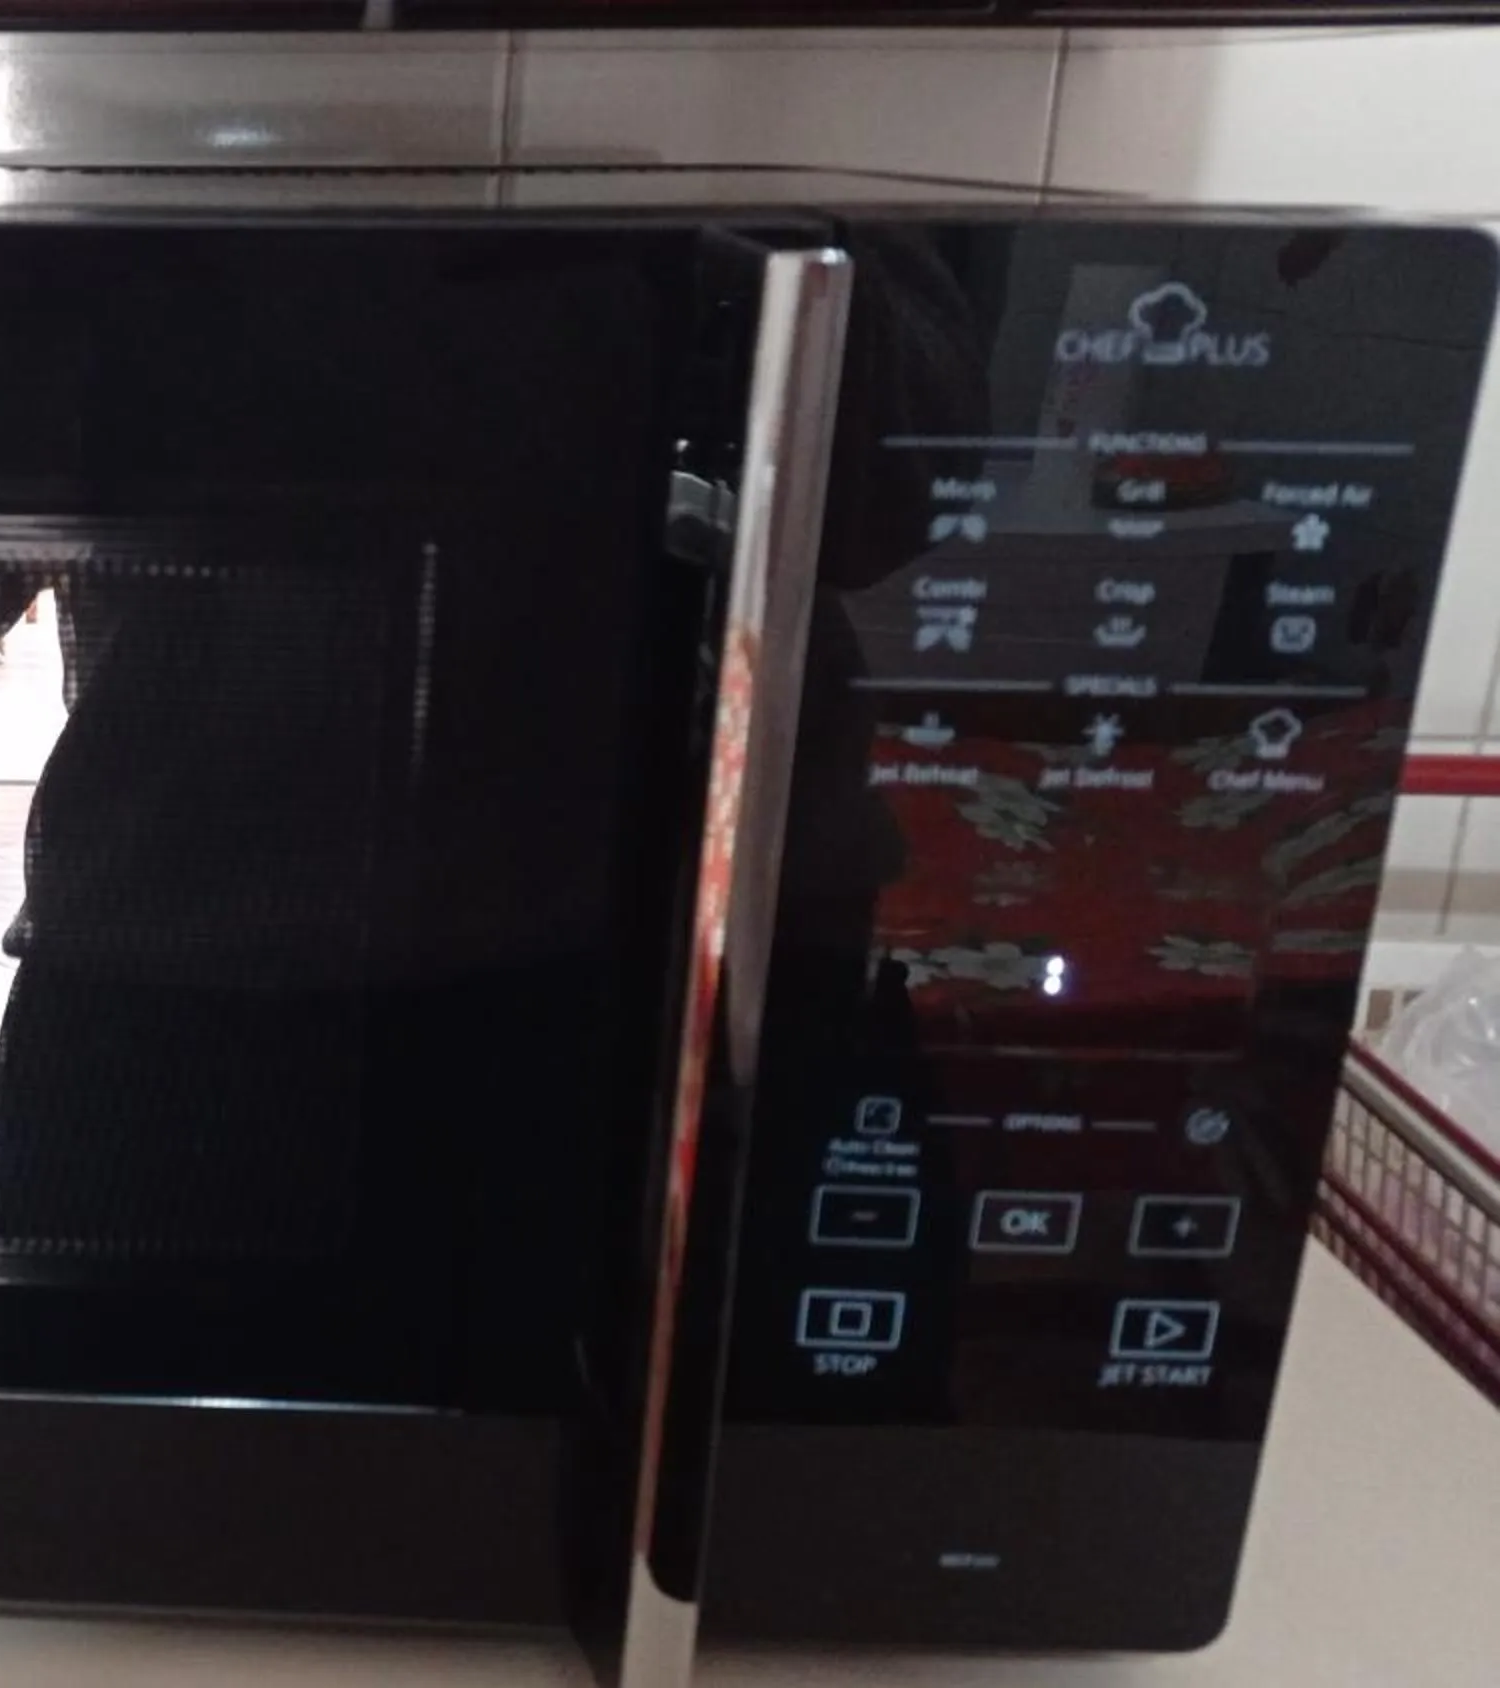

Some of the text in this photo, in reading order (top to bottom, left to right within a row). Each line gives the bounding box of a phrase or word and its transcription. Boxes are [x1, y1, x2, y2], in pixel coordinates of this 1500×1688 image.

[1055, 330, 1271, 365] CHEF PLUS
[1089, 433, 1206, 452] FUNCTIONS
[1116, 479, 1166, 504] Grill
[1261, 481, 1373, 508] Forced Air
[914, 577, 987, 602] Combi
[1098, 579, 1155, 605] Crisp
[1267, 582, 1334, 606] Steam
[1062, 675, 1156, 696] SPECIALS
[1208, 770, 1324, 792] Chef Menu
[1000, 1208, 1050, 1236] OK
[814, 1353, 877, 1375] STOP
[1100, 1364, 1213, 1387] JET START
